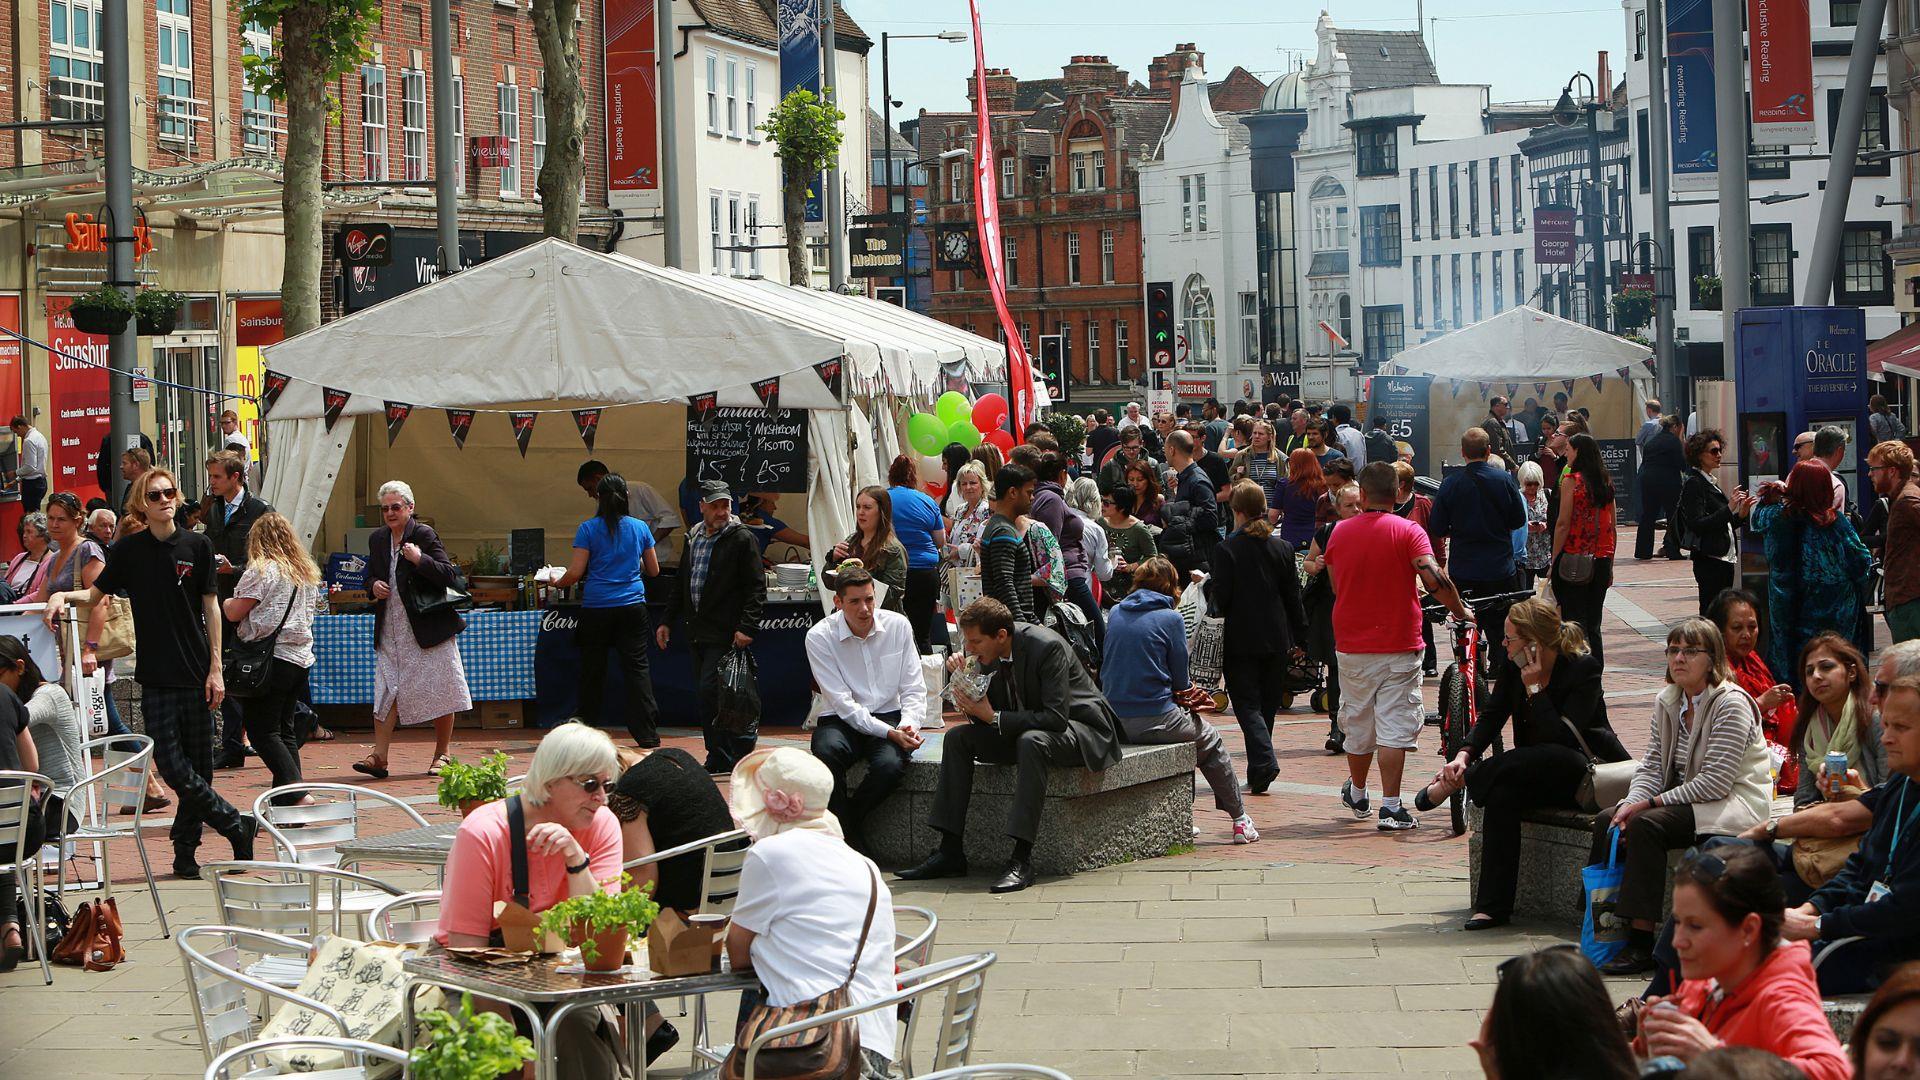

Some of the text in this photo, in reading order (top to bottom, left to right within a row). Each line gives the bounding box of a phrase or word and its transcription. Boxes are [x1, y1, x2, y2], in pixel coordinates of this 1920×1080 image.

[1760, 41, 1772, 83] Reading
[1677, 65, 1688, 144] rewarding Reading
[614, 83, 624, 161] surprising Reading
[865, 238, 887, 251] The
[1541, 240, 1569, 248] George
[1545, 248, 1566, 256] Hotel
[852, 253, 901, 267] Alehouse
[240, 316, 284, 327] Sainsbur
[55, 337, 109, 371] Sainsbur
[1806, 350, 1857, 373] ORACLE
[239, 374, 255, 405] TO
[1177, 385, 1210, 394] BURGER KING
[1821, 384, 1849, 392] RIVERSIDE
[754, 422, 801, 437] MUSHROOM
[1390, 419, 1412, 437] £5
[757, 437, 795, 451] RISOTTO
[1600, 449, 1630, 458] GGEST
[758, 612, 813, 630] uccio's
